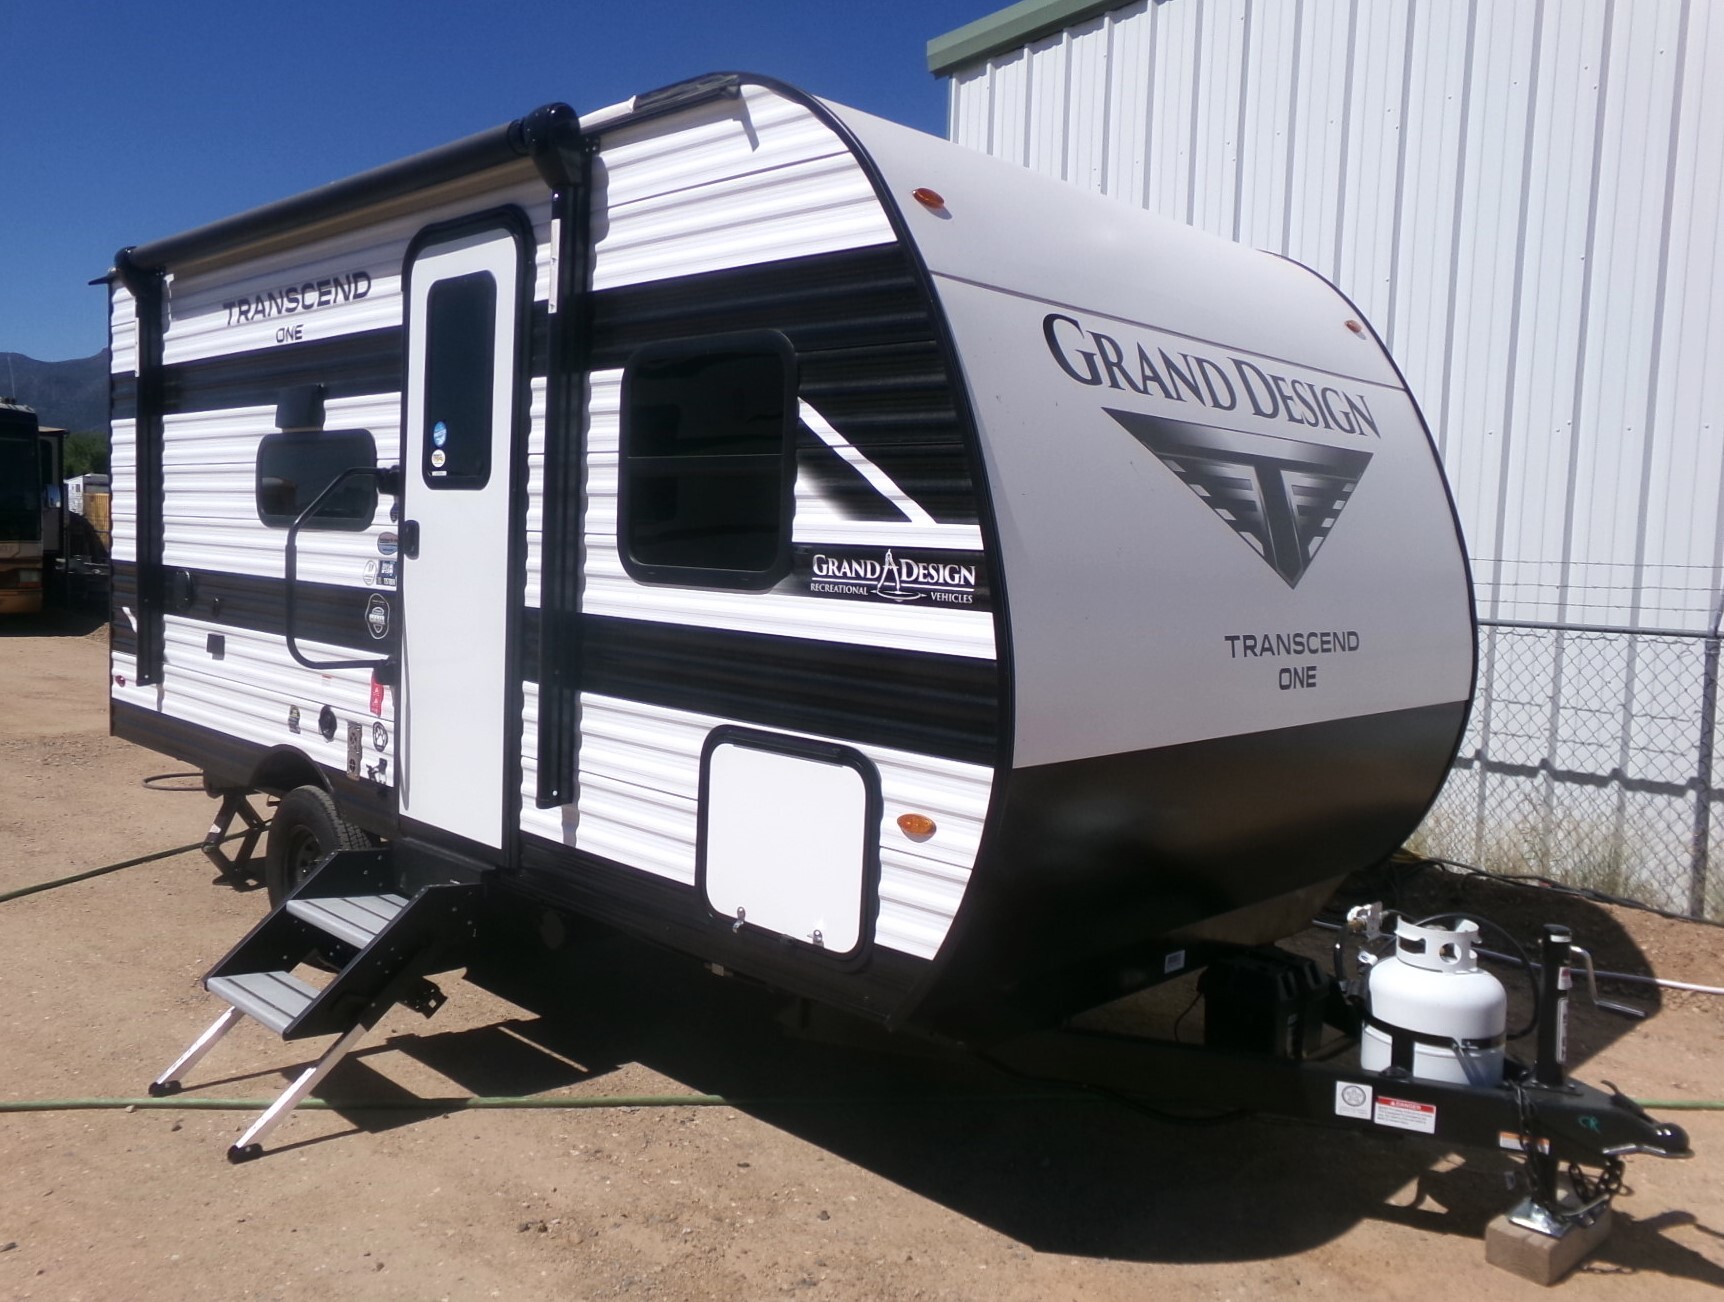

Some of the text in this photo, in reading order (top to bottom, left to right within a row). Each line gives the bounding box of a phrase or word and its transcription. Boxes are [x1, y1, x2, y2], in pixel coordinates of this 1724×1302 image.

[222, 270, 372, 326] TRANSCEND
[275, 323, 304, 343] ONE
[1042, 312, 1382, 440] GRAND DESIGN
[812, 554, 976, 586] GRAND DESIGN
[810, 583, 973, 604] RECREATIONAL VEHICLES
[1224, 630, 1360, 659] TRANSCEND
[1278, 665, 1317, 691] ONE
